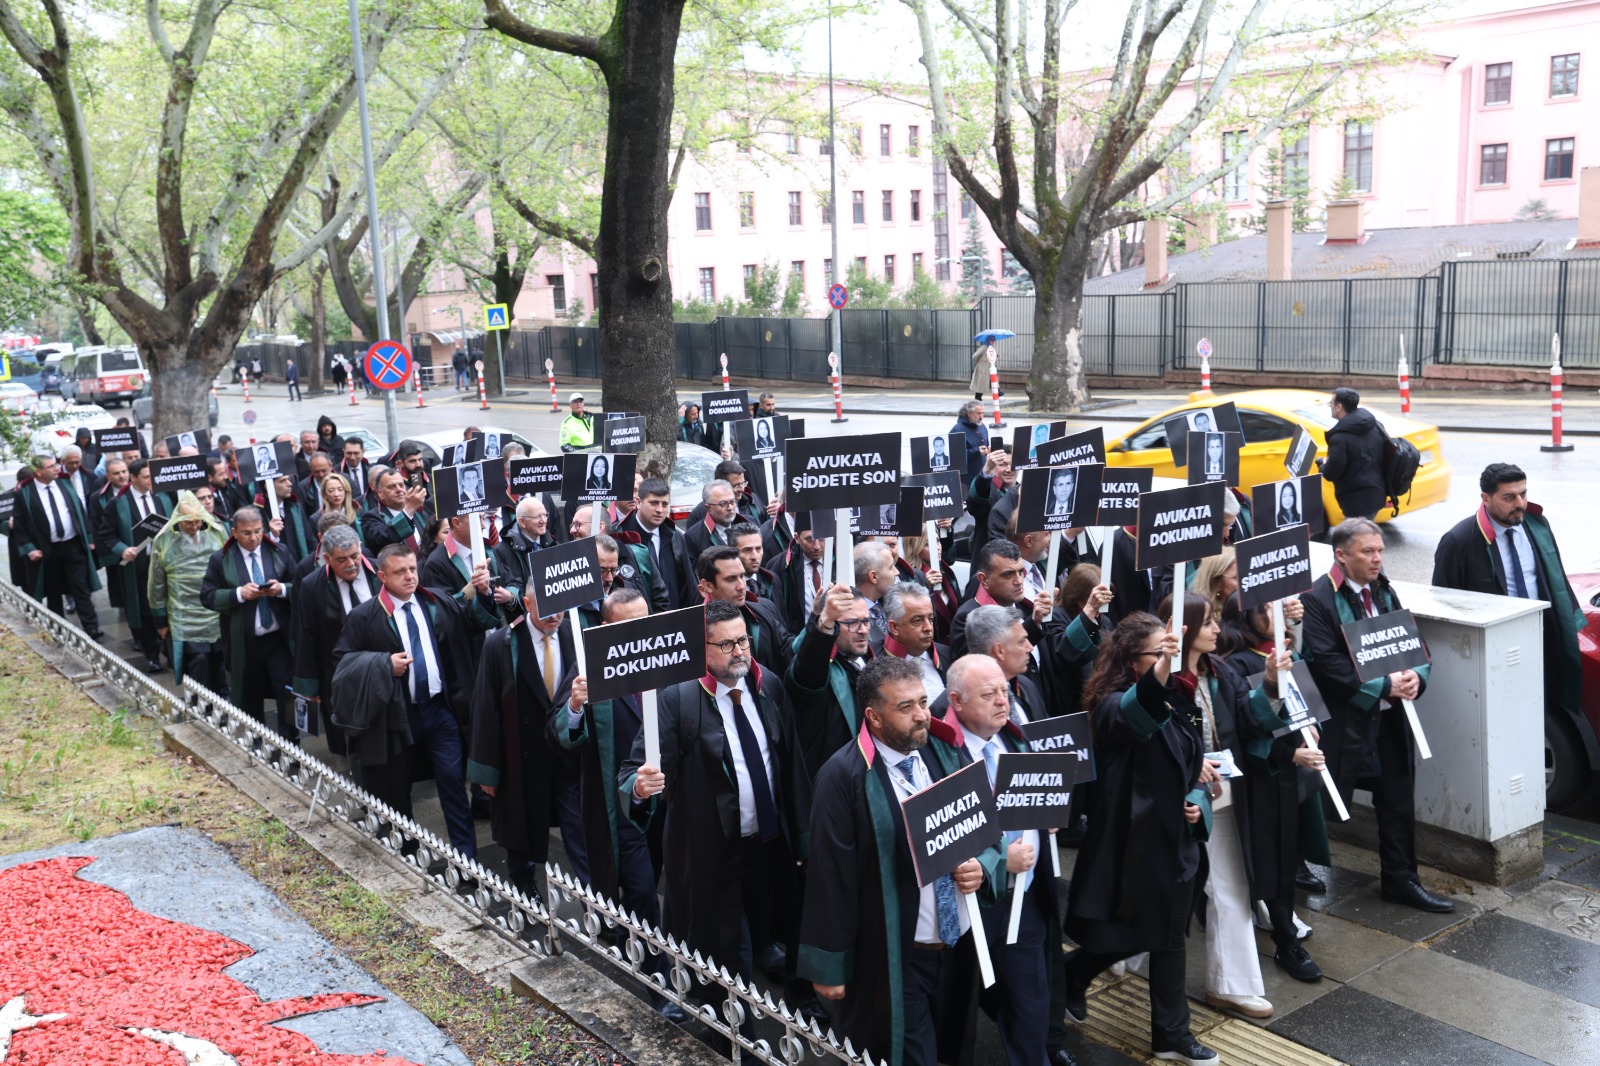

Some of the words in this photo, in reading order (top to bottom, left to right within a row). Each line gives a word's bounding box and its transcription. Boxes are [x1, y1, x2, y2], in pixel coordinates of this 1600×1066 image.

[708, 406, 744, 415] DOKUNMA
[710, 398, 741, 407] AVUKATA
[102, 432, 132, 440] AVUKATA
[610, 436, 640, 446] DOKUNMA
[612, 427, 640, 437] AVUKATA
[100, 439, 134, 448] DOKUNMA
[806, 452, 882, 470] AVUKATA
[1050, 444, 1094, 464] AVUKATA
[154, 472, 188, 484] ŞİDDETE
[188, 471, 206, 480] SON
[160, 464, 198, 474] AVUKATA
[521, 465, 558, 475] AVUKATA
[513, 474, 548, 486] ŞİDDETE
[792, 472, 860, 492] ŞİDDETE
[862, 470, 896, 484] SON
[1102, 483, 1140, 494] UKATA
[924, 485, 950, 496] KATA
[924, 496, 954, 508] UNMA
[1124, 498, 1140, 508] SO
[1154, 505, 1212, 528] AVUKATA
[1150, 524, 1214, 547] DOKUNMA
[1250, 545, 1300, 570] AVUKATA
[545, 556, 590, 580] AVUKATA
[1242, 566, 1286, 592] ŞİDDETE
[1287, 558, 1308, 576] SON
[544, 572, 594, 597] DOKUNMA
[1360, 626, 1408, 646] AVUKATA
[606, 632, 686, 660] AVUKATA
[1356, 642, 1399, 665] ŞİDDETE
[1398, 638, 1421, 652] SON
[604, 650, 690, 680] DOKUNMA
[1030, 734, 1074, 752] KATA
[1010, 774, 1062, 788] AVUKATA
[996, 790, 1044, 810] ŞİDDETE
[1045, 792, 1070, 806] SON
[926, 790, 980, 833] AVUKATA
[926, 810, 988, 856] DOKUNMA
